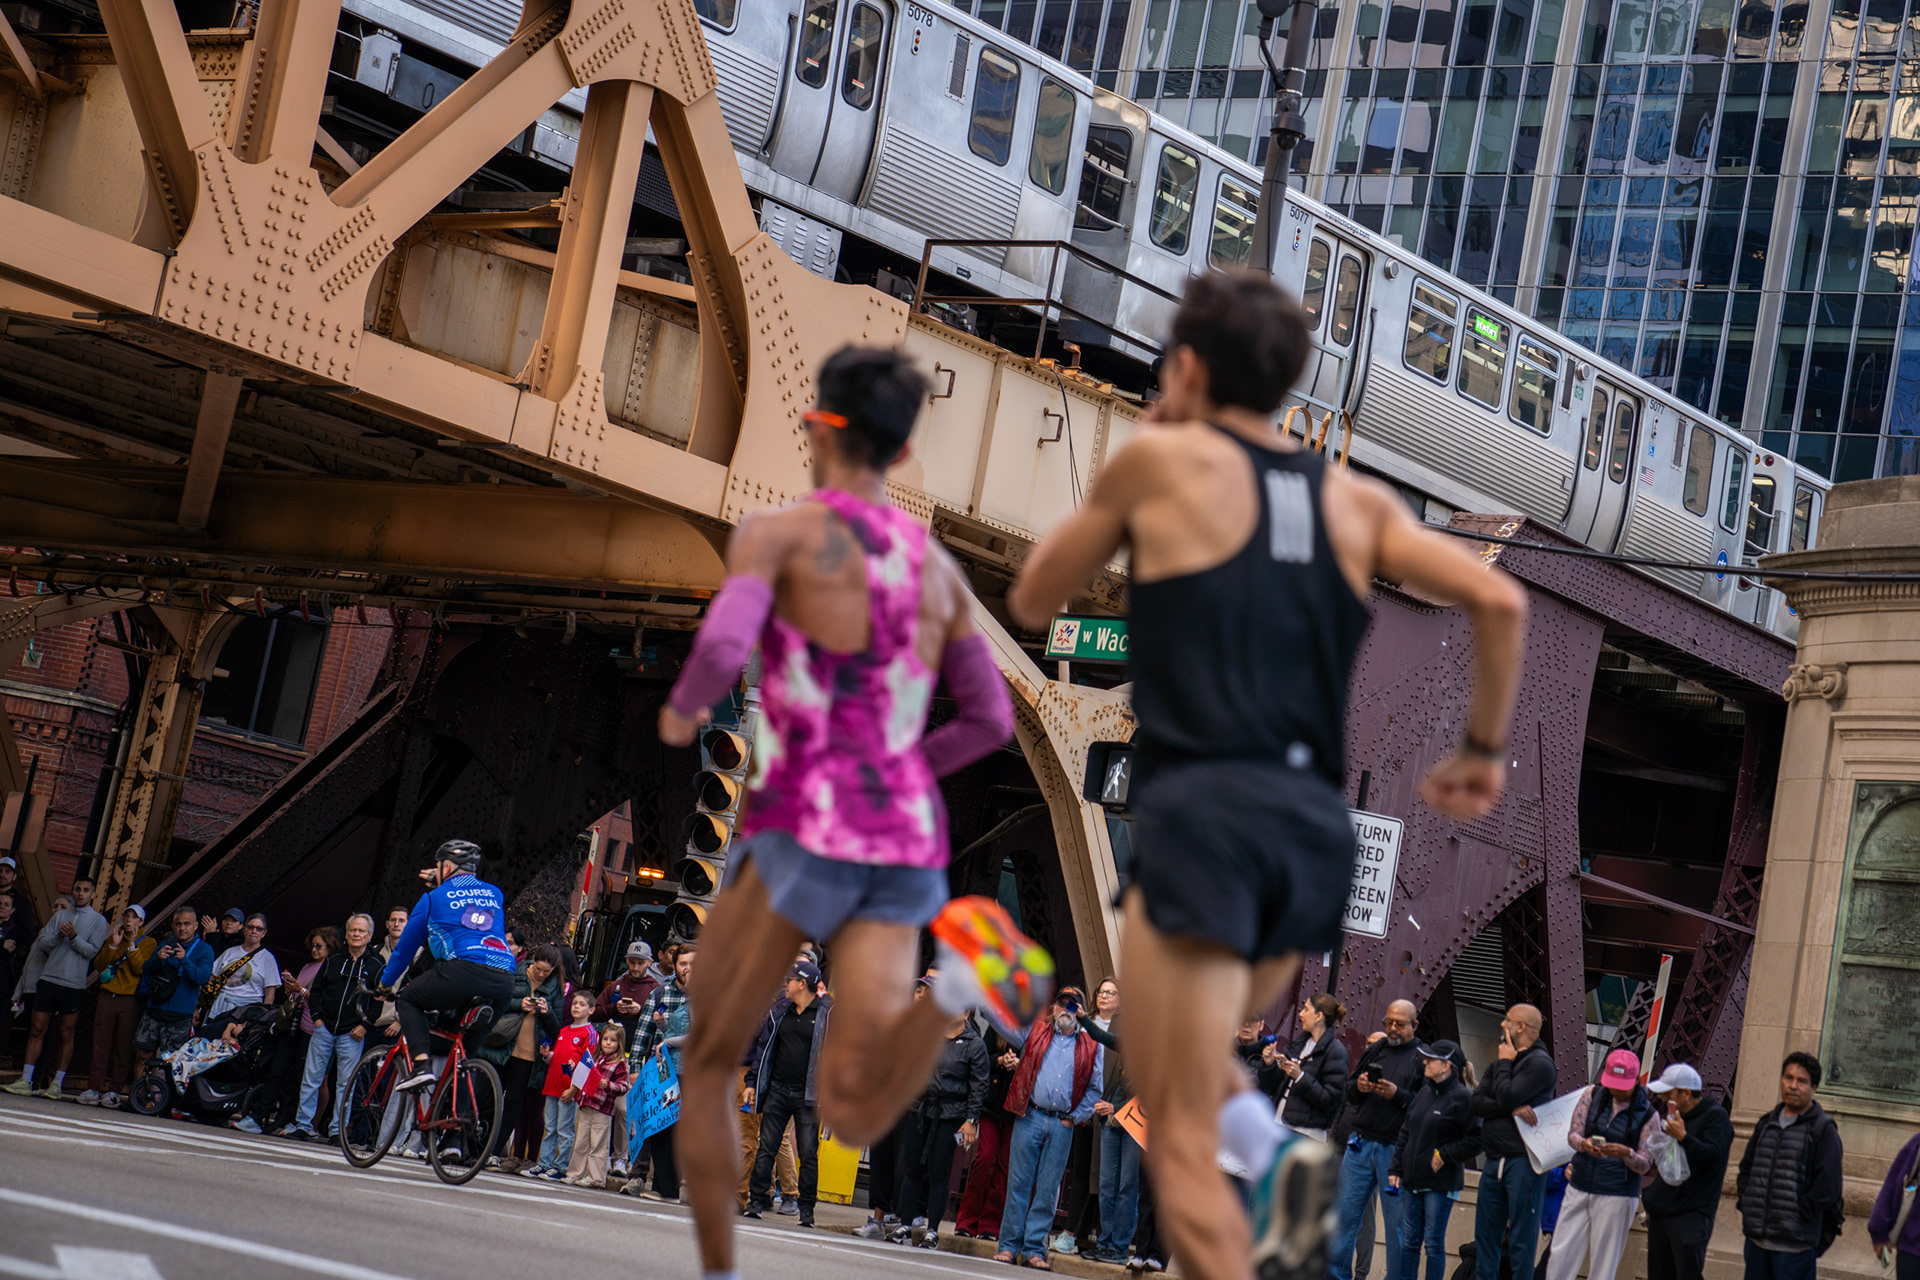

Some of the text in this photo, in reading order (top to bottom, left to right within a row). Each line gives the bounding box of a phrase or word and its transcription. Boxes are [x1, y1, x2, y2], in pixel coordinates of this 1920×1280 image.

[908, 4, 933, 27] 5078
[1289, 205, 1309, 224] 5077
[1649, 399, 1665, 415] 5077
[1096, 627, 1130, 652] Wac
[1355, 822, 1392, 843] TURN
[1355, 844, 1384, 862] RED
[1352, 864, 1380, 882] EPT
[446, 889, 495, 898] COURSE
[1347, 884, 1386, 905] REEN
[450, 898, 501, 909] OFFICIAL
[1343, 904, 1373, 922] ROW
